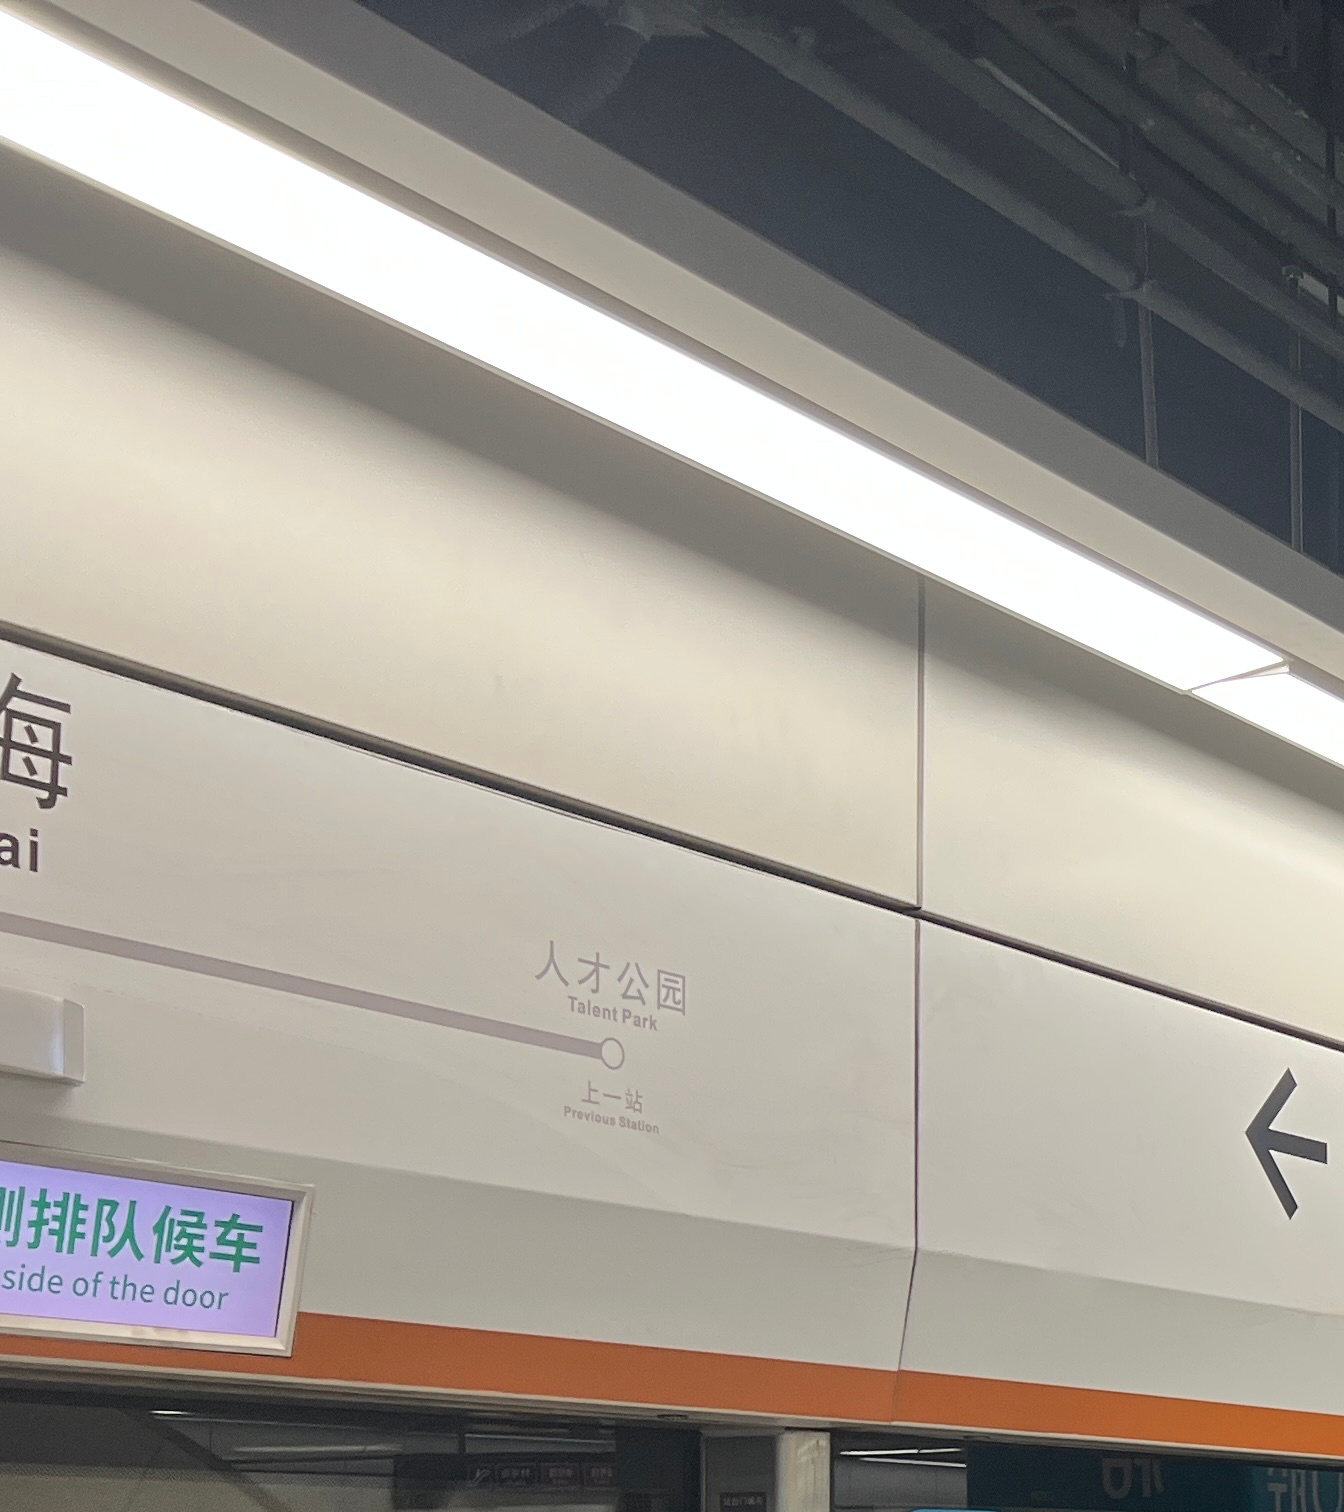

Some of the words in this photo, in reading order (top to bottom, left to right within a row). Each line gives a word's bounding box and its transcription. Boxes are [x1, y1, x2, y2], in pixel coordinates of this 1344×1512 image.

[535, 940, 686, 1016] 人才公园
[567, 995, 618, 1023] Talent
[622, 1008, 658, 1031] Park
[581, 1080, 644, 1114] 上一站
[563, 1106, 616, 1126] Previous
[618, 1116, 660, 1135] Station
[1, 1263, 63, 1295] side
[72, 1271, 104, 1298] of
[109, 1274, 156, 1304] the
[163, 1280, 229, 1310] door
